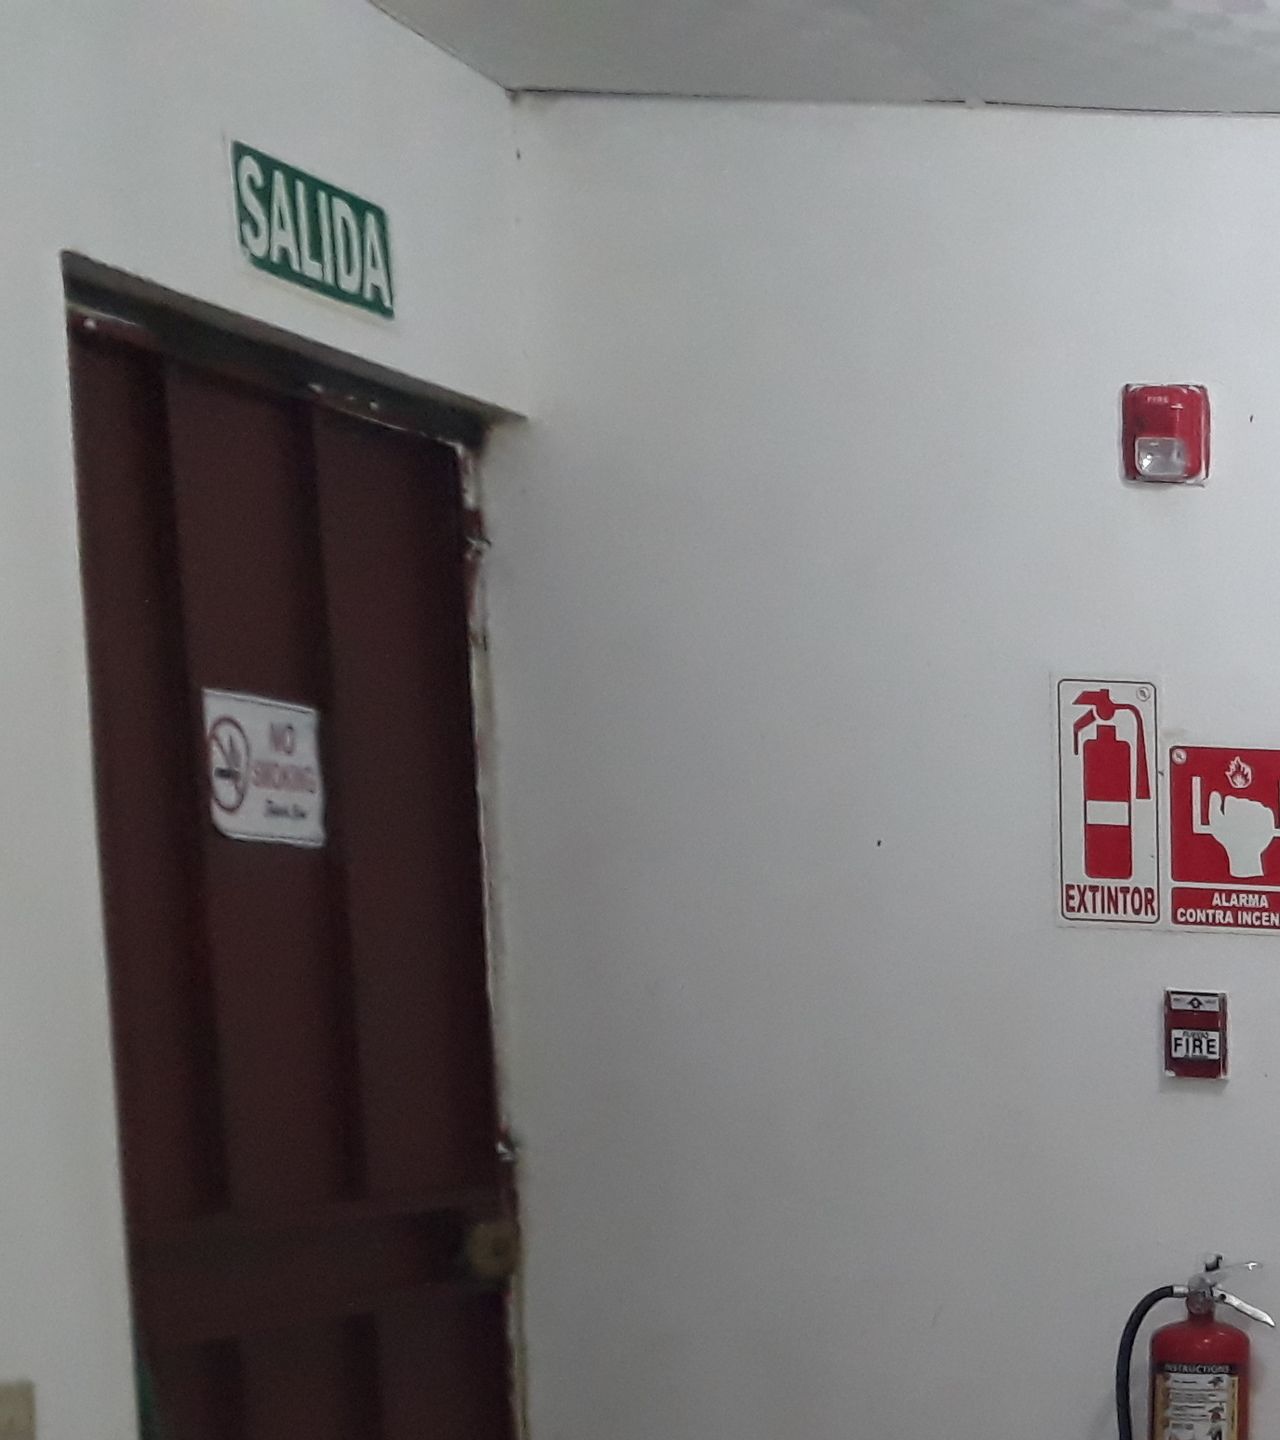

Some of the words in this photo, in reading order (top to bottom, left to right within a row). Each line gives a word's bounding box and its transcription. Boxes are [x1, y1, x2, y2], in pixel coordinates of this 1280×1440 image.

[237, 154, 394, 309] SALIDA
[1065, 883, 1156, 917] EXTINTOR
[1211, 892, 1269, 909] ALARMA
[1176, 907, 1233, 925] CONTRA
[1174, 1037, 1217, 1055] FIRE
